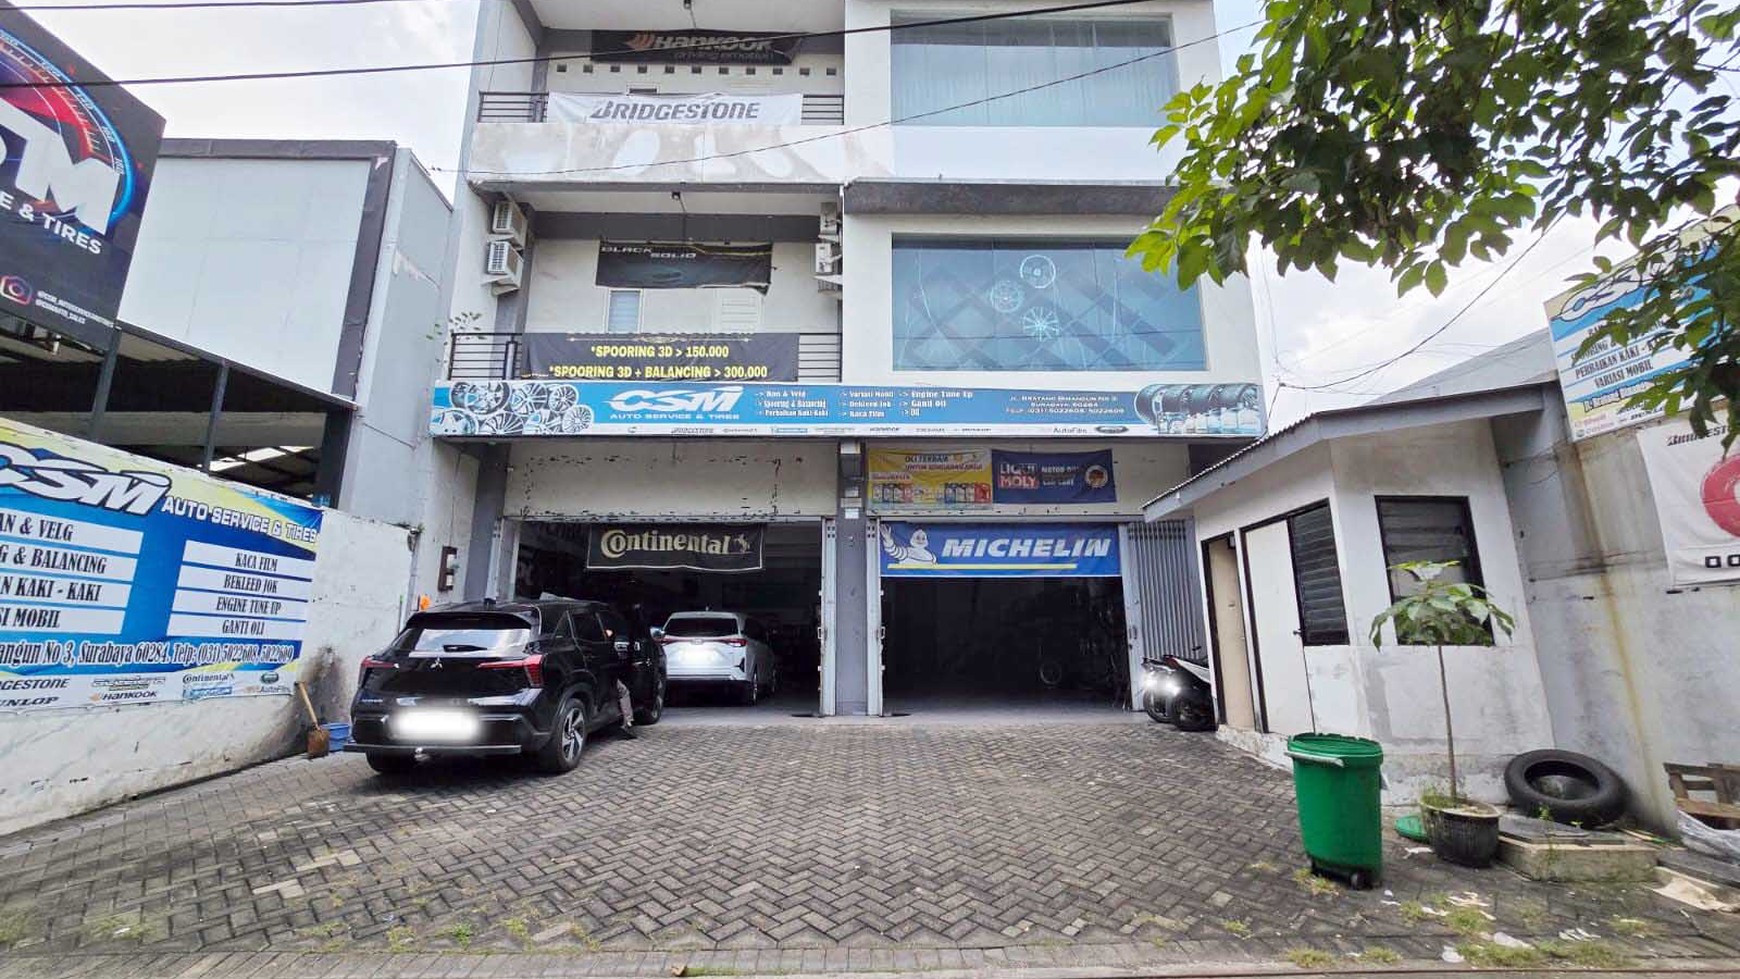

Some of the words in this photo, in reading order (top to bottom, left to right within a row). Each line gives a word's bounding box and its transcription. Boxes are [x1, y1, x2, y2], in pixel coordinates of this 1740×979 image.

[590, 100, 760, 120] BRIDGESTONE
[18, 203, 34, 222] &
[42, 212, 102, 255] TIRES
[658, 345, 672, 358] 3D
[686, 345, 729, 358] 150.000
[1575, 356, 1618, 379] PERBAIKAN
[1620, 346, 1640, 362] KAKI
[617, 365, 632, 378] 3D
[645, 366, 711, 378] BALANCING
[723, 365, 768, 379] 300.000
[1594, 371, 1625, 387] VARIASI
[1626, 359, 1653, 377] MOBIL
[602, 386, 744, 412] CSM
[20, 517, 32, 535] &
[39, 519, 74, 542] VELG
[161, 497, 209, 520] AUTO
[212, 507, 270, 532] SERVICE
[272, 520, 282, 536] &
[287, 523, 318, 543] TIRES
[601, 529, 731, 558] Continental
[942, 538, 1111, 557] MICHELIN
[13, 546, 26, 565] &
[30, 548, 108, 574] BALANCING
[235, 552, 258, 570] KACA
[259, 557, 278, 572] FILM
[15, 577, 55, 598] KAKI
[66, 582, 103, 602] KAKI
[223, 573, 263, 591] BEKLEED
[263, 580, 279, 593] JOK
[216, 597, 248, 613] ENGINE
[249, 600, 270, 614] TUNE
[270, 602, 282, 614] UP
[13, 608, 61, 628] MOBIL
[222, 619, 249, 634] GANTI
[250, 622, 265, 635] OLI
[43, 641, 60, 664] No
[63, 641, 75, 666] 3,
[79, 642, 134, 666] Surabaya
[173, 643, 195, 666] Telp:
[198, 644, 220, 664] (031)
[182, 673, 228, 684] Continental
